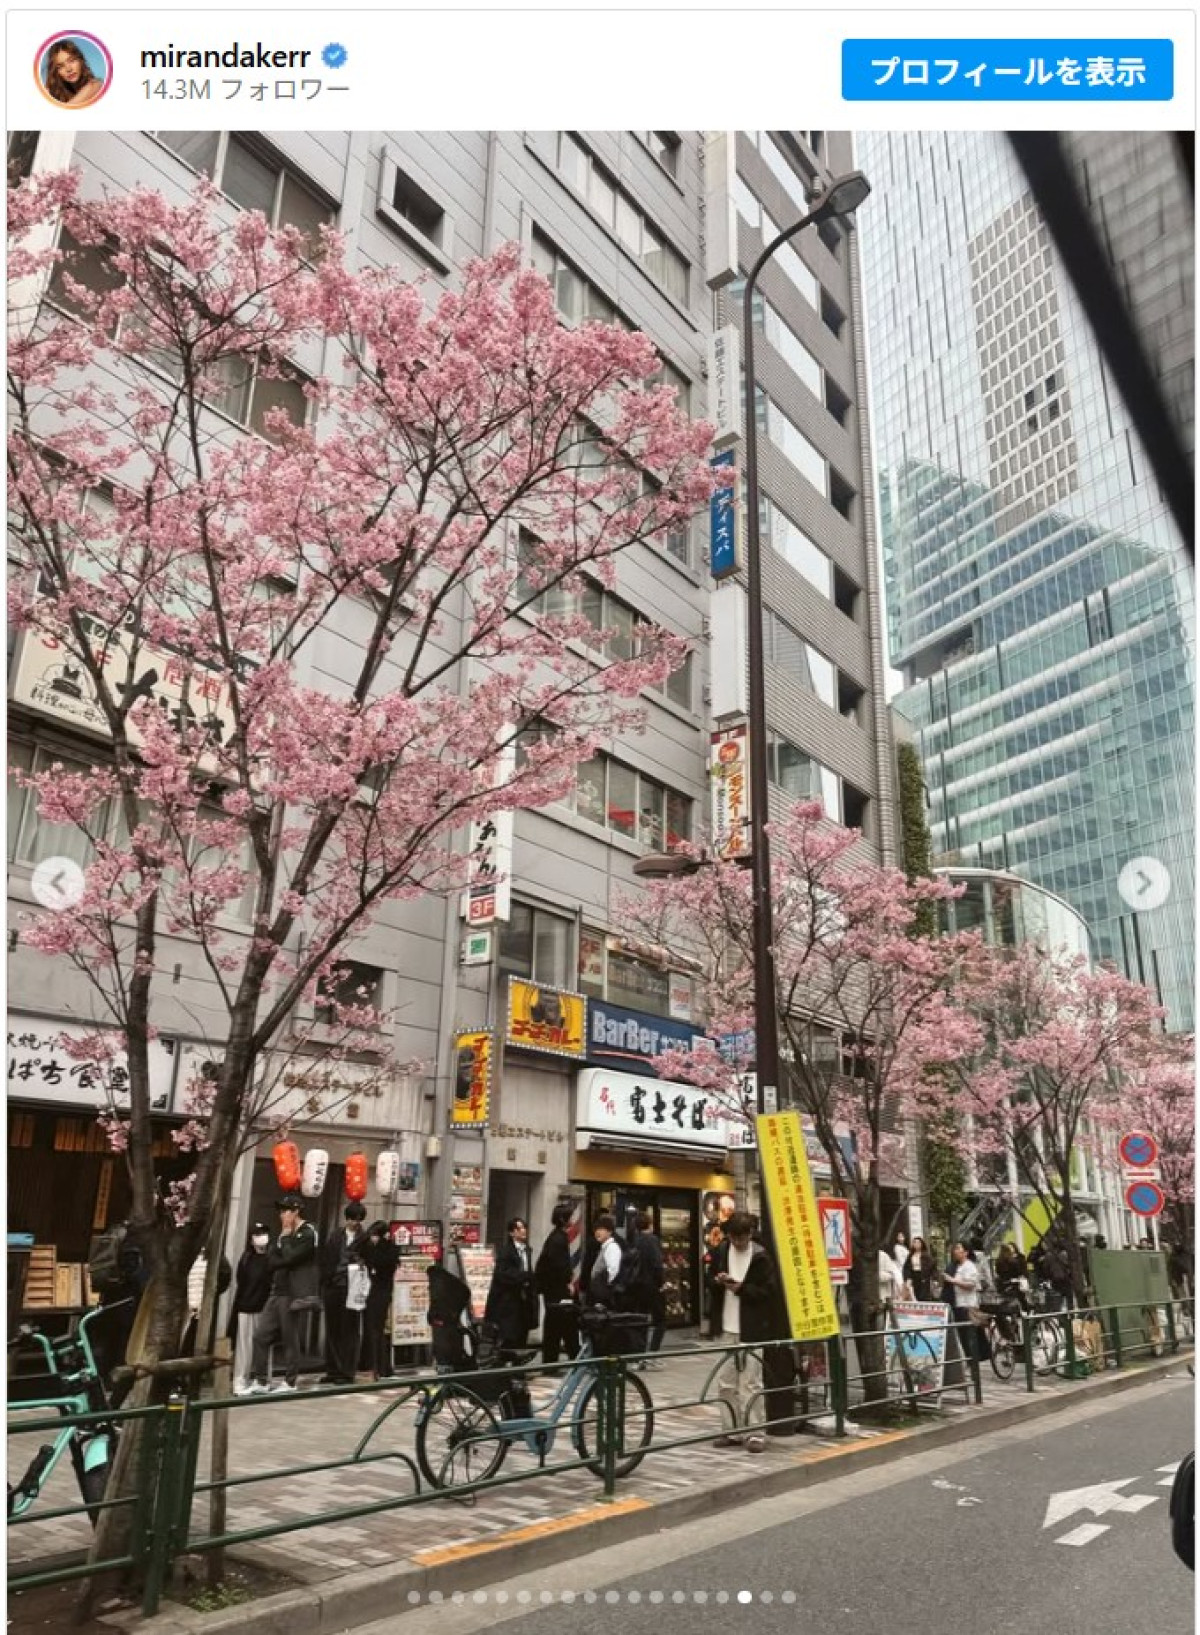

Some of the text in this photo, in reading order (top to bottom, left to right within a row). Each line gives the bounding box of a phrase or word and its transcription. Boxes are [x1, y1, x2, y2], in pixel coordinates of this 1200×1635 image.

[470, 901, 495, 920] 3F
[592, 1009, 661, 1055] BarBer
[629, 1085, 708, 1131] 富士そば
